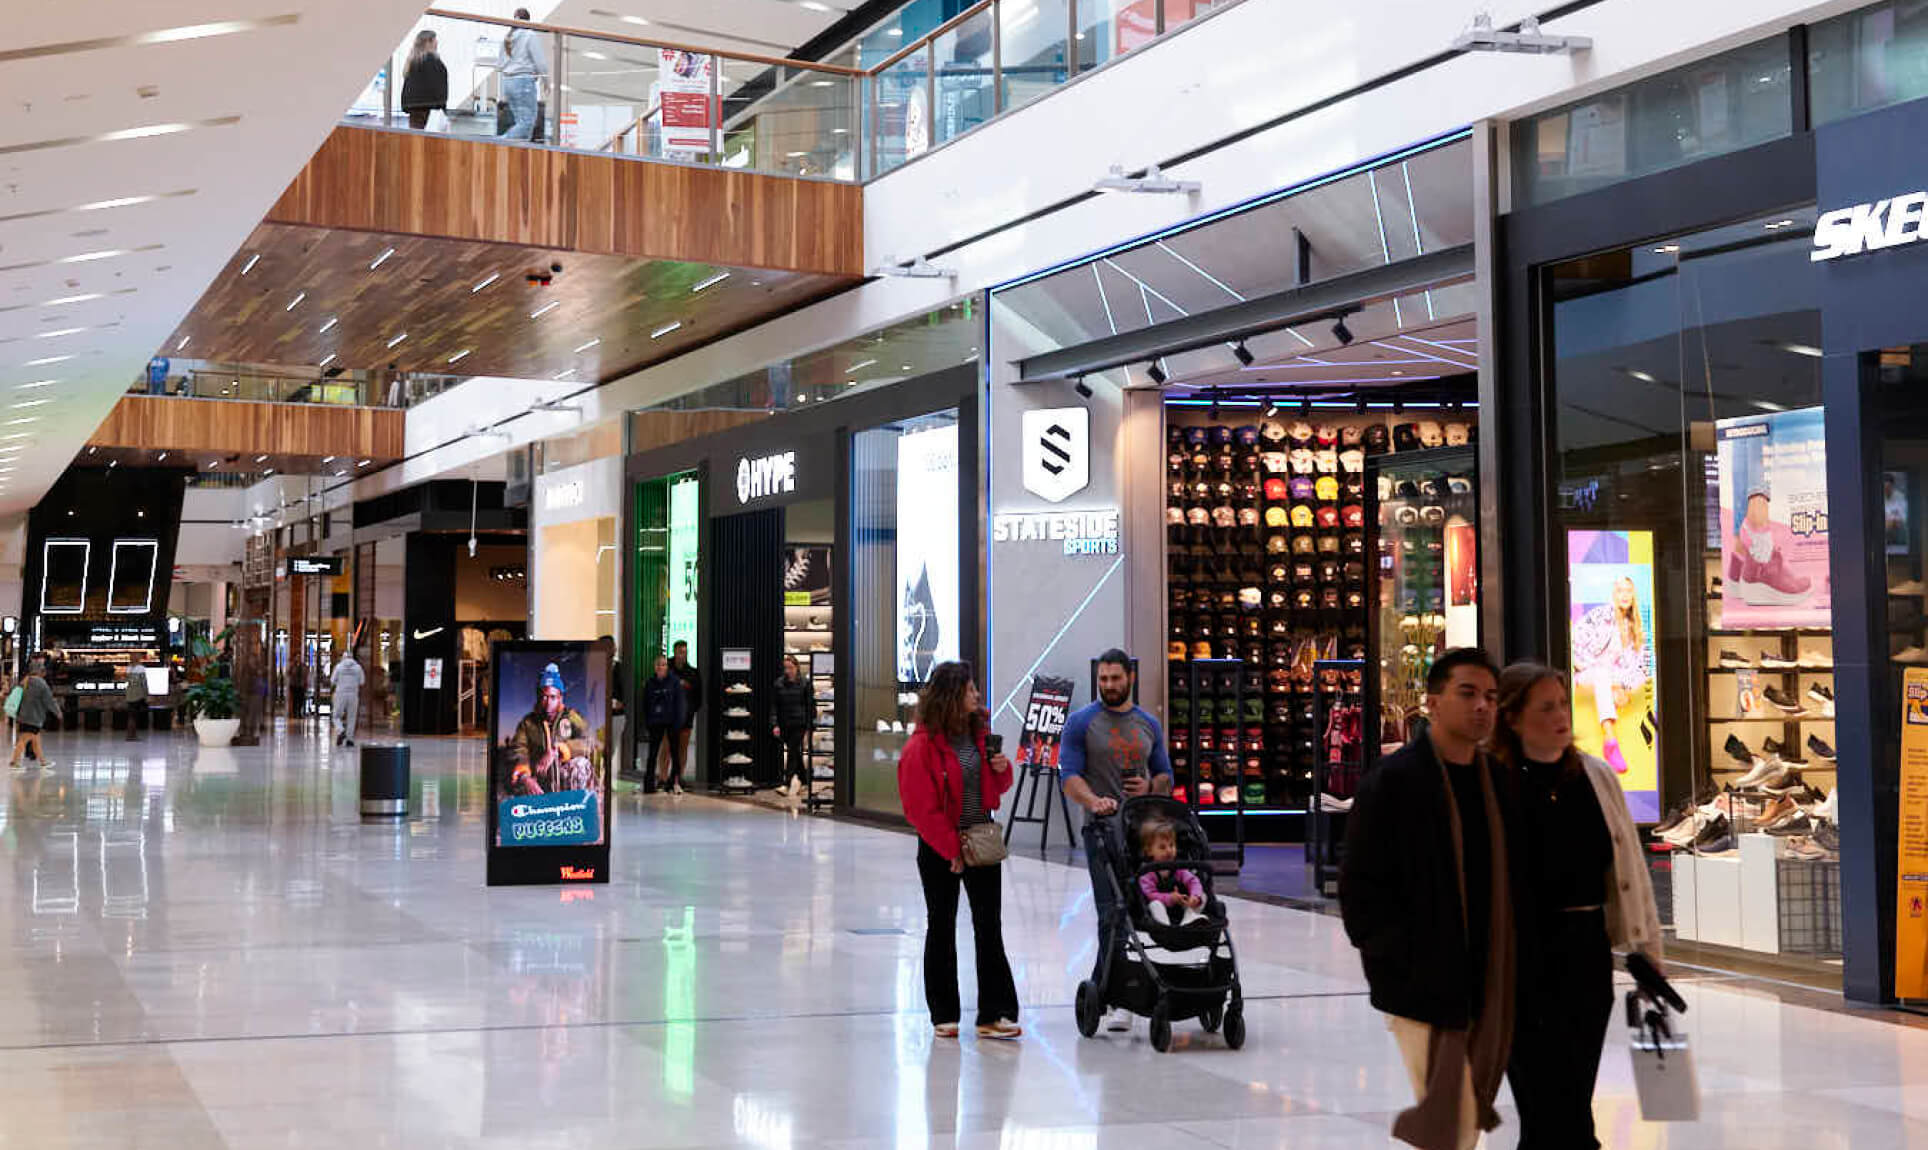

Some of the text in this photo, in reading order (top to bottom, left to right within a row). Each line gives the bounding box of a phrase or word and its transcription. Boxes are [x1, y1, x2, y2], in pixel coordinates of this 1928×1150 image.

[751, 452, 795, 498] HYPE
[993, 512, 1119, 542] STATESIDE
[1063, 537, 1119, 555] SPORTS
[1026, 703, 1065, 732] 50%
[510, 803, 587, 818] Champion
